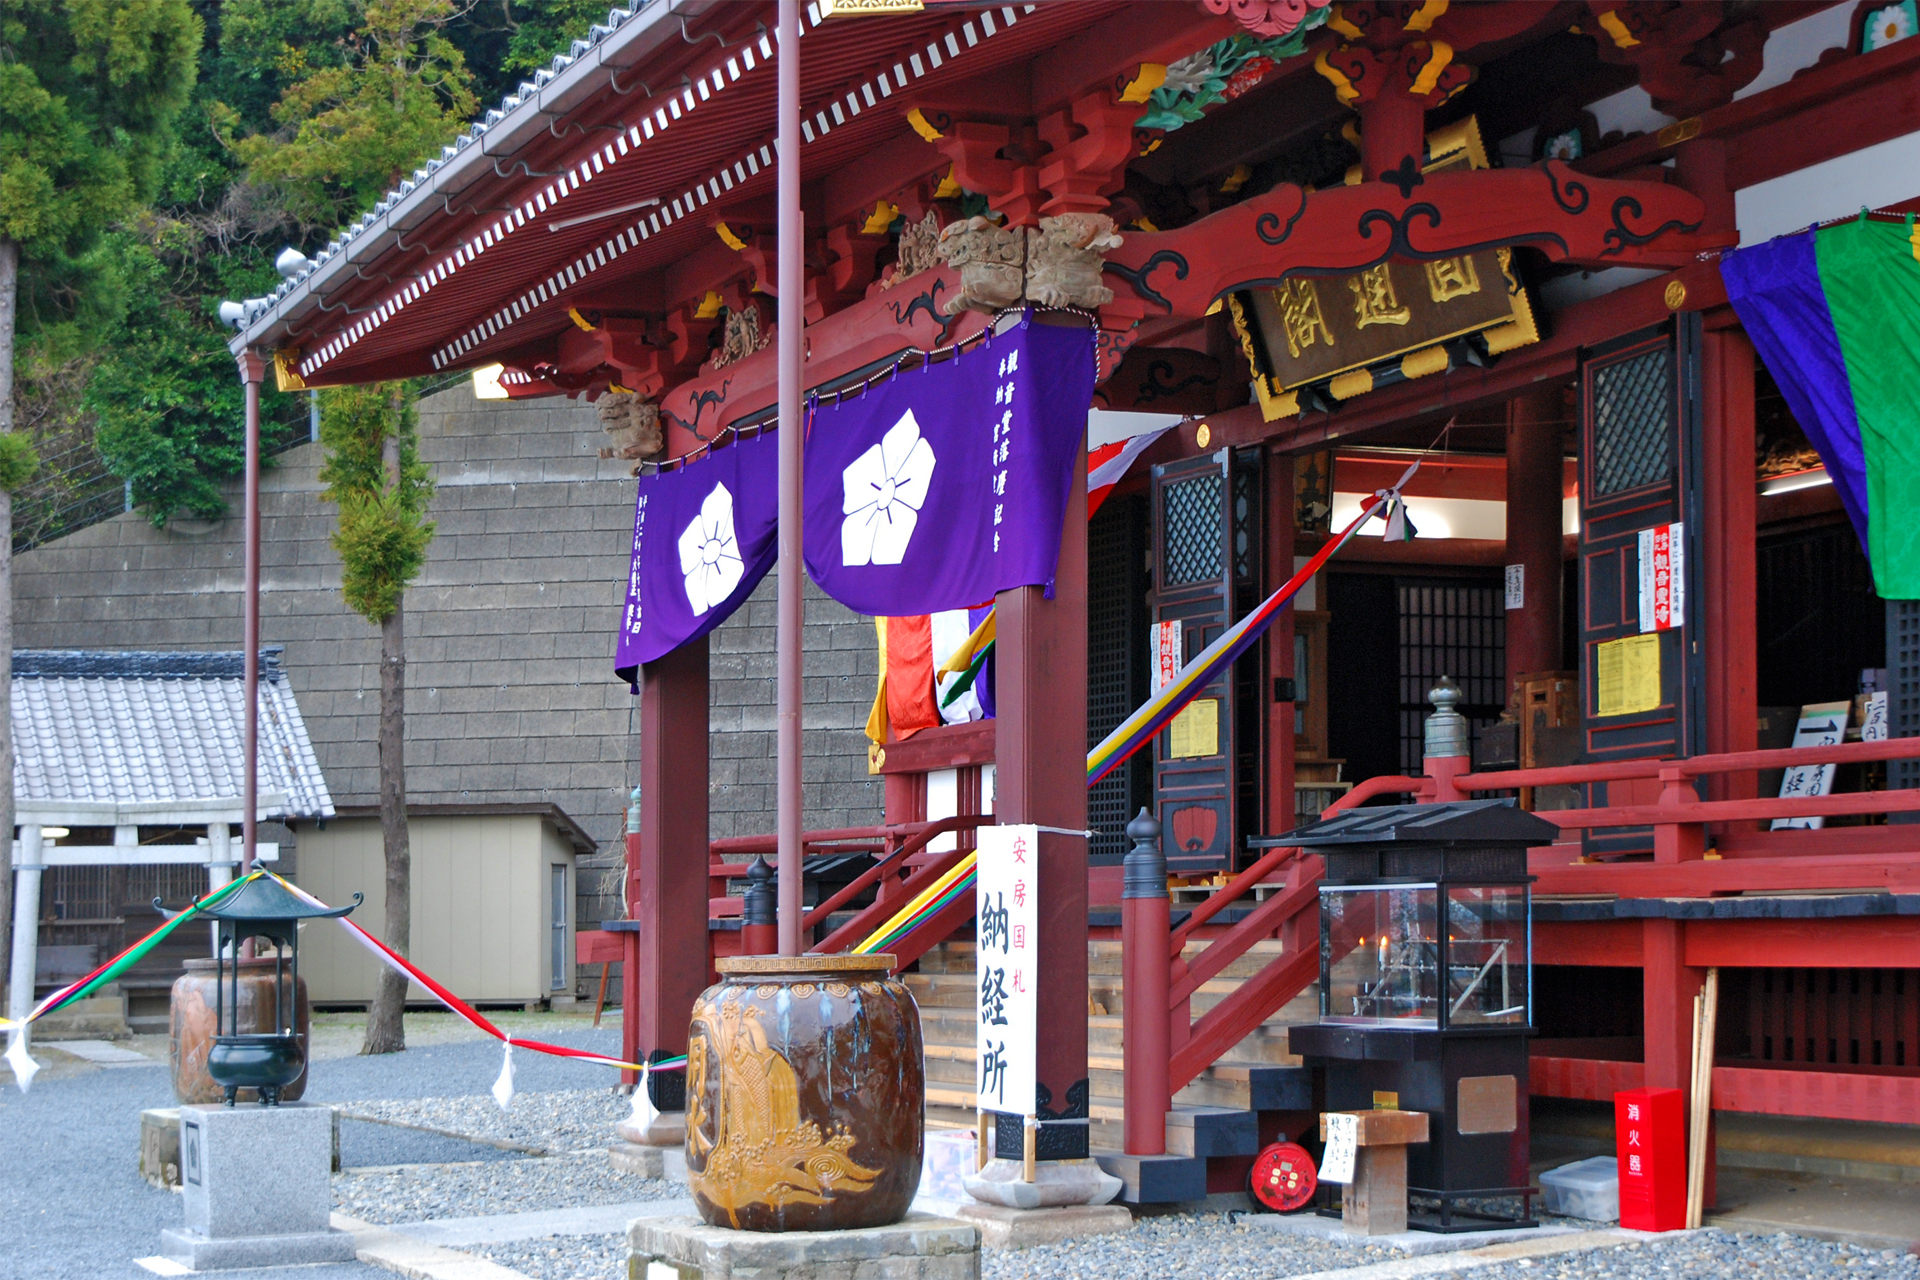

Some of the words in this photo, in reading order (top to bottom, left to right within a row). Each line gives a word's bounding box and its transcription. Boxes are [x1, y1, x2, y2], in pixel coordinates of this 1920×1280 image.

[1012, 836, 1027, 994] 安房国札
[980, 891, 1009, 1106] 納経所
[1628, 1104, 1640, 1172] 消火器
